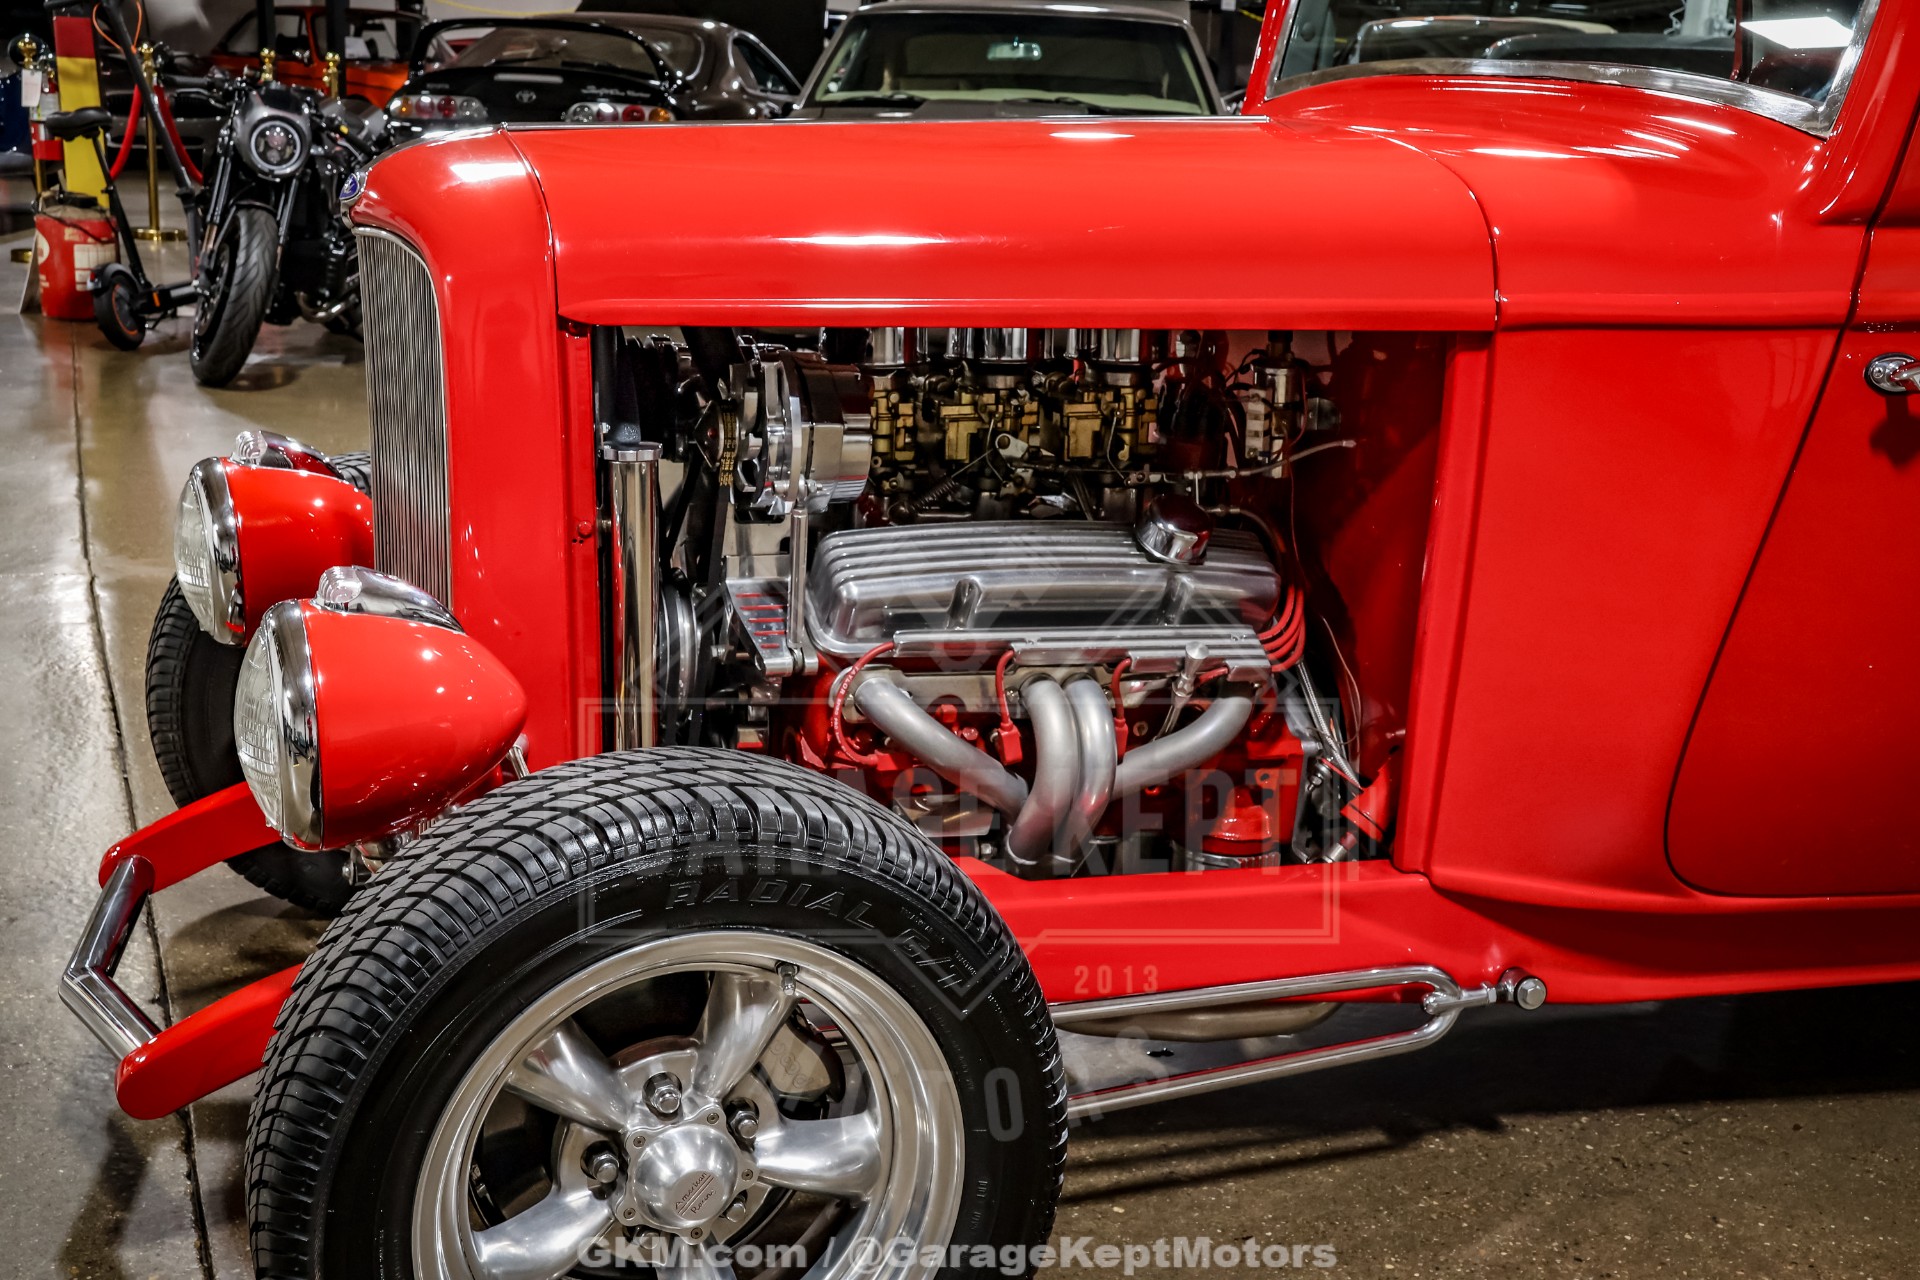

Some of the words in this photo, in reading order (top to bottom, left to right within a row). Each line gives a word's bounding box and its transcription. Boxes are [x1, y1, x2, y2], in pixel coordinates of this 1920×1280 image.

[840, 666, 859, 695] TAYLOR
[665, 877, 876, 932] RADIAL
[675, 1172, 707, 1210] American
